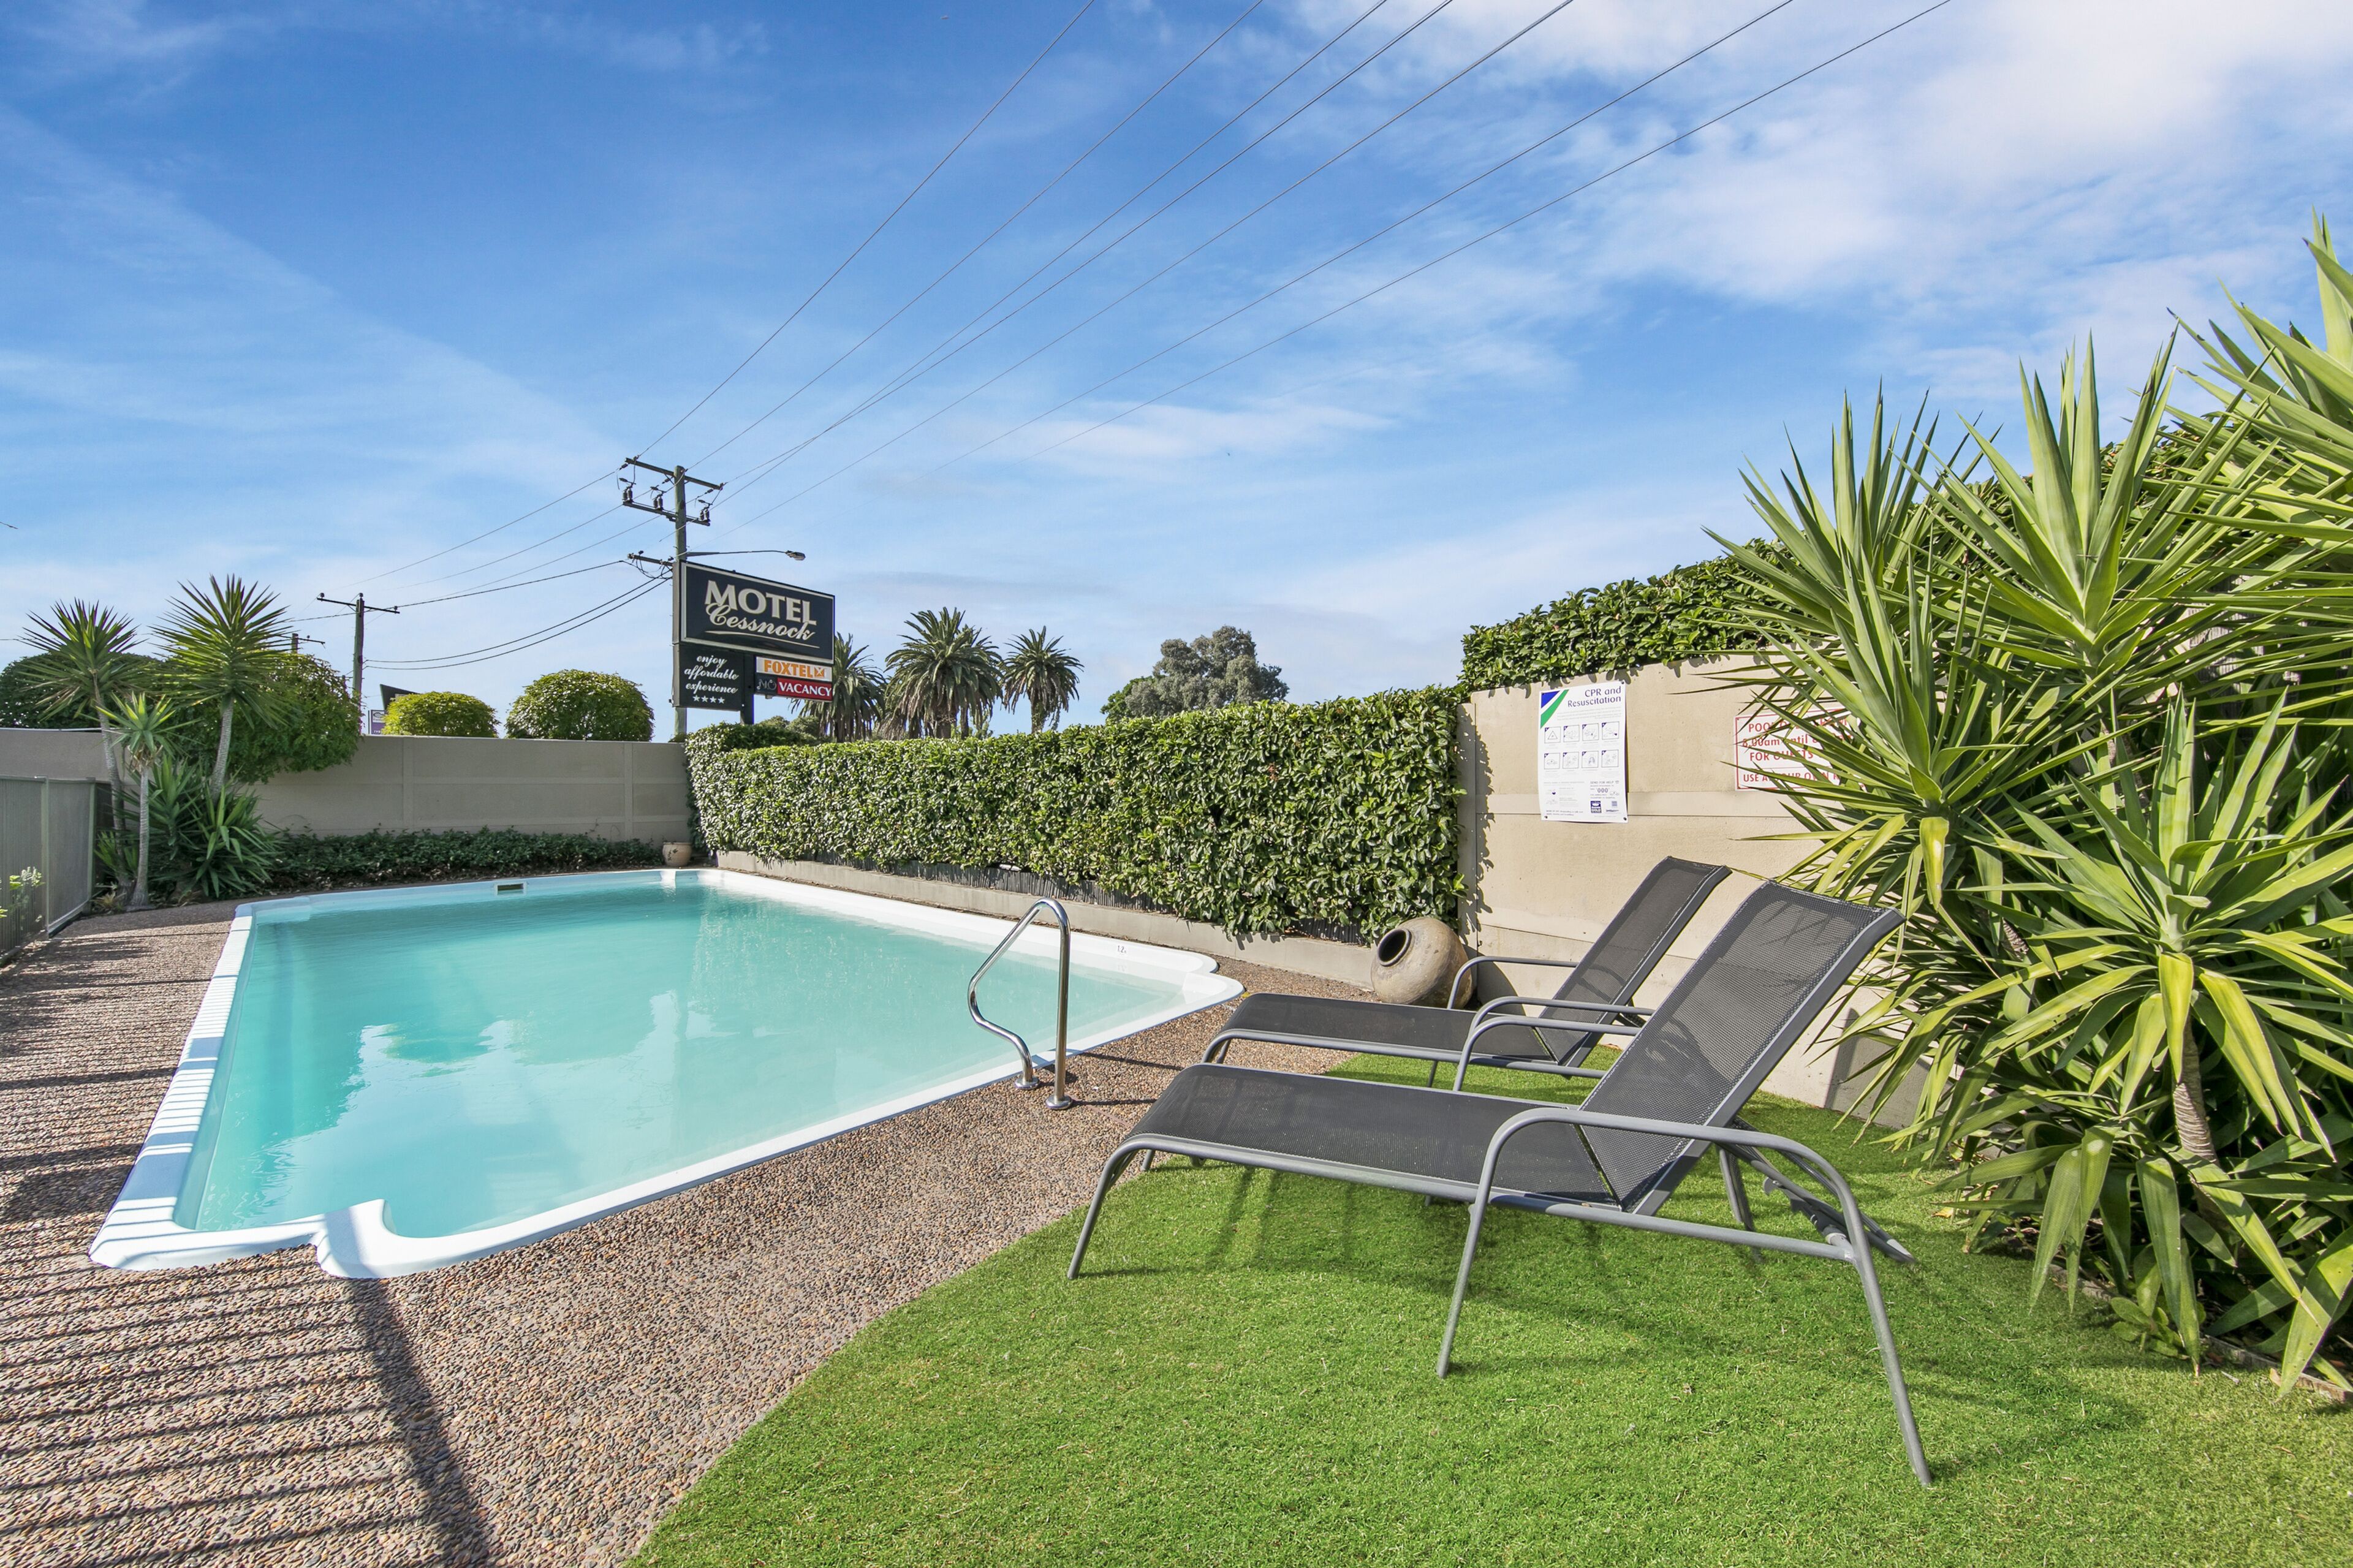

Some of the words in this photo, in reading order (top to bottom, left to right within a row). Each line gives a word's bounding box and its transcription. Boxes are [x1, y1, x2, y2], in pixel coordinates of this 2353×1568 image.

[704, 580, 817, 626] MOTEL
[705, 603, 816, 641] Cessnock
[696, 654, 727, 669] enjoy
[763, 659, 814, 678] FOXTEL
[684, 665, 739, 681] affordable
[685, 681, 738, 694] experience
[757, 678, 777, 691] NO
[778, 681, 832, 697] VACANCY
[1584, 688, 1602, 698] CPR
[1604, 686, 1621, 695] and
[1567, 695, 1621, 708] Resuscitation
[1748, 722, 1775, 733] POO
[1749, 752, 1770, 761] FOR
